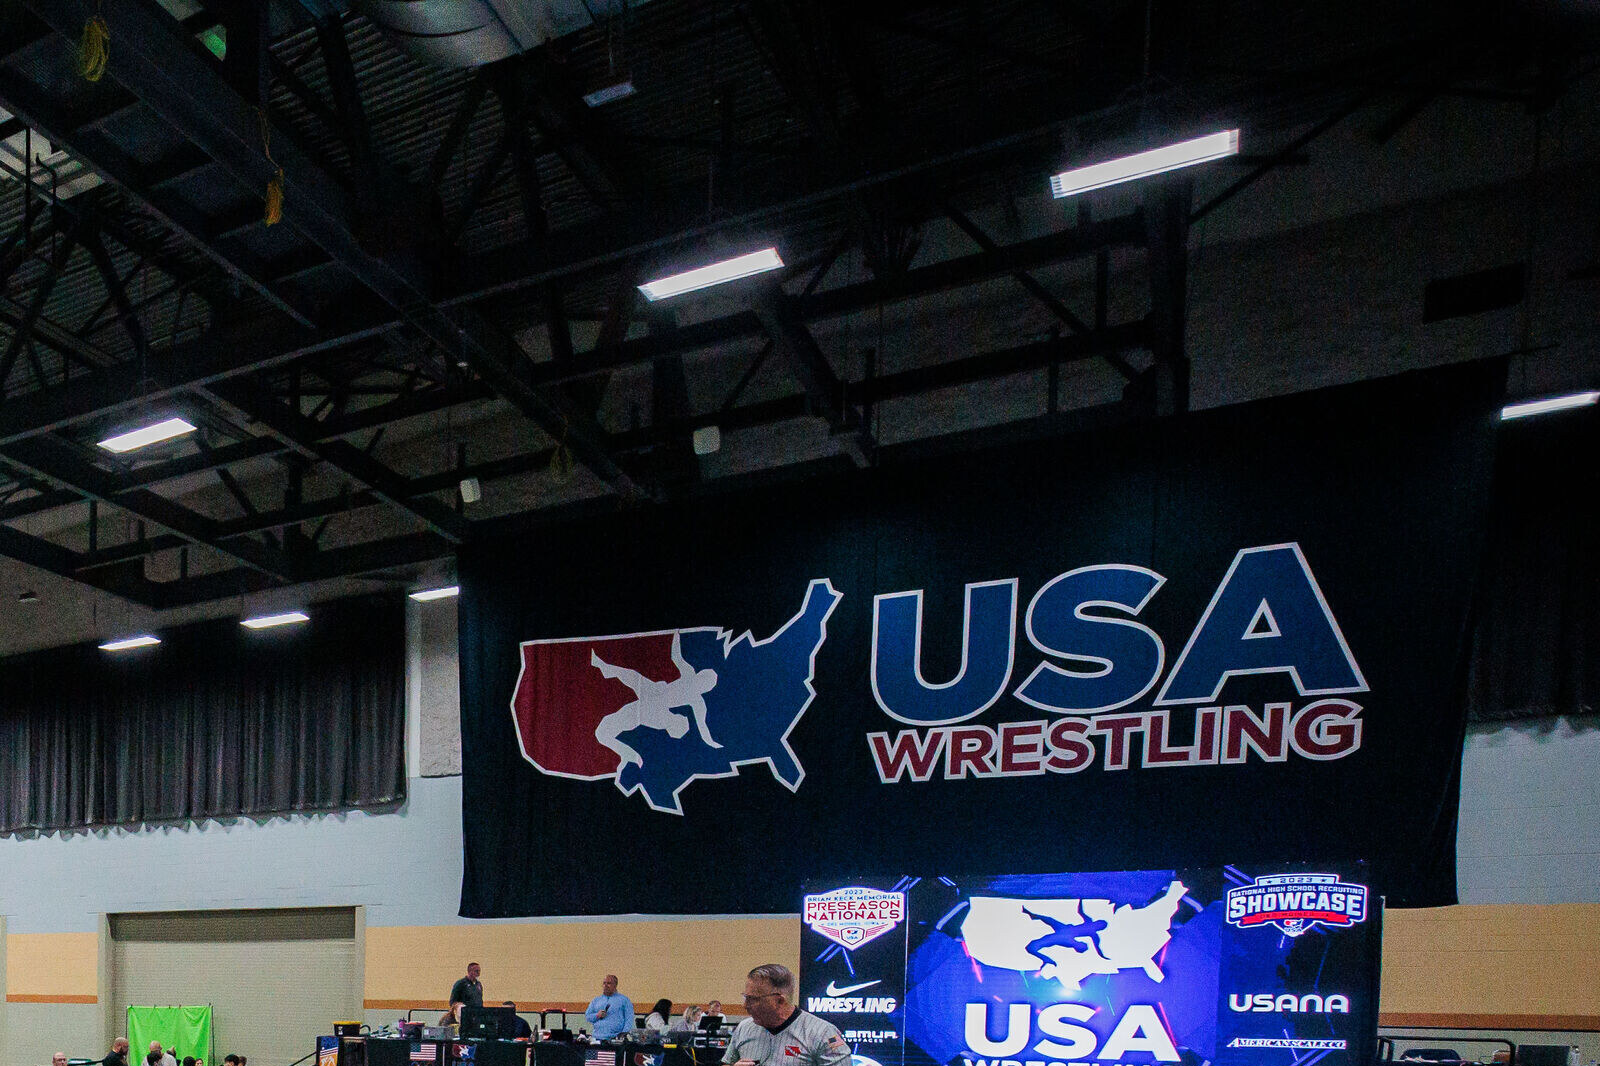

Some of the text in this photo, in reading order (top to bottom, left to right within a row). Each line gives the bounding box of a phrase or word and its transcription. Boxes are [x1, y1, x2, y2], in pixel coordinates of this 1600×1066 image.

[870, 541, 1371, 726] USA
[866, 699, 1364, 784] WRESTLING
[1231, 888, 1266, 898] NATIONAL
[1318, 885, 1364, 895] RECRUITING
[807, 900, 900, 911] PRESEASON
[807, 910, 900, 921] NATIONALS
[1229, 892, 1362, 919] SHOWCASE
[807, 997, 897, 1014] WRESTLING
[1228, 993, 1349, 1013] USANA
[964, 1002, 1182, 1062] USA
